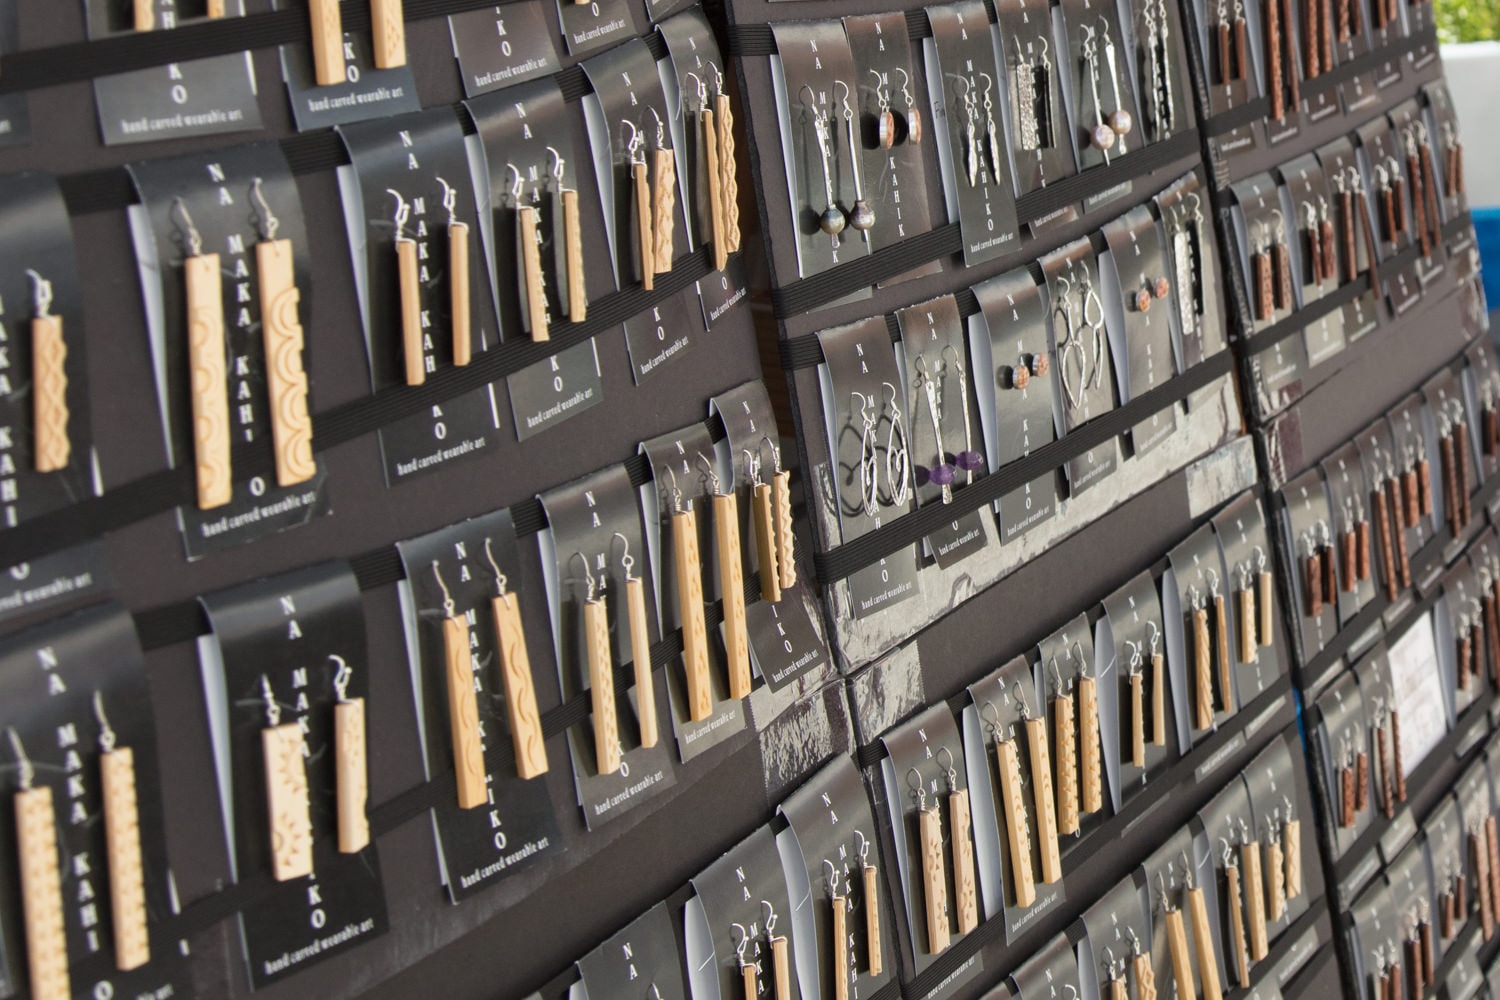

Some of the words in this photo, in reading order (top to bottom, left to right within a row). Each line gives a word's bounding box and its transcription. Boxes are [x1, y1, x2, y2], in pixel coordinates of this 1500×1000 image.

[228, 234, 251, 328] MAKA
[414, 197, 431, 283] MAKA
[57, 723, 88, 825] MAKA
